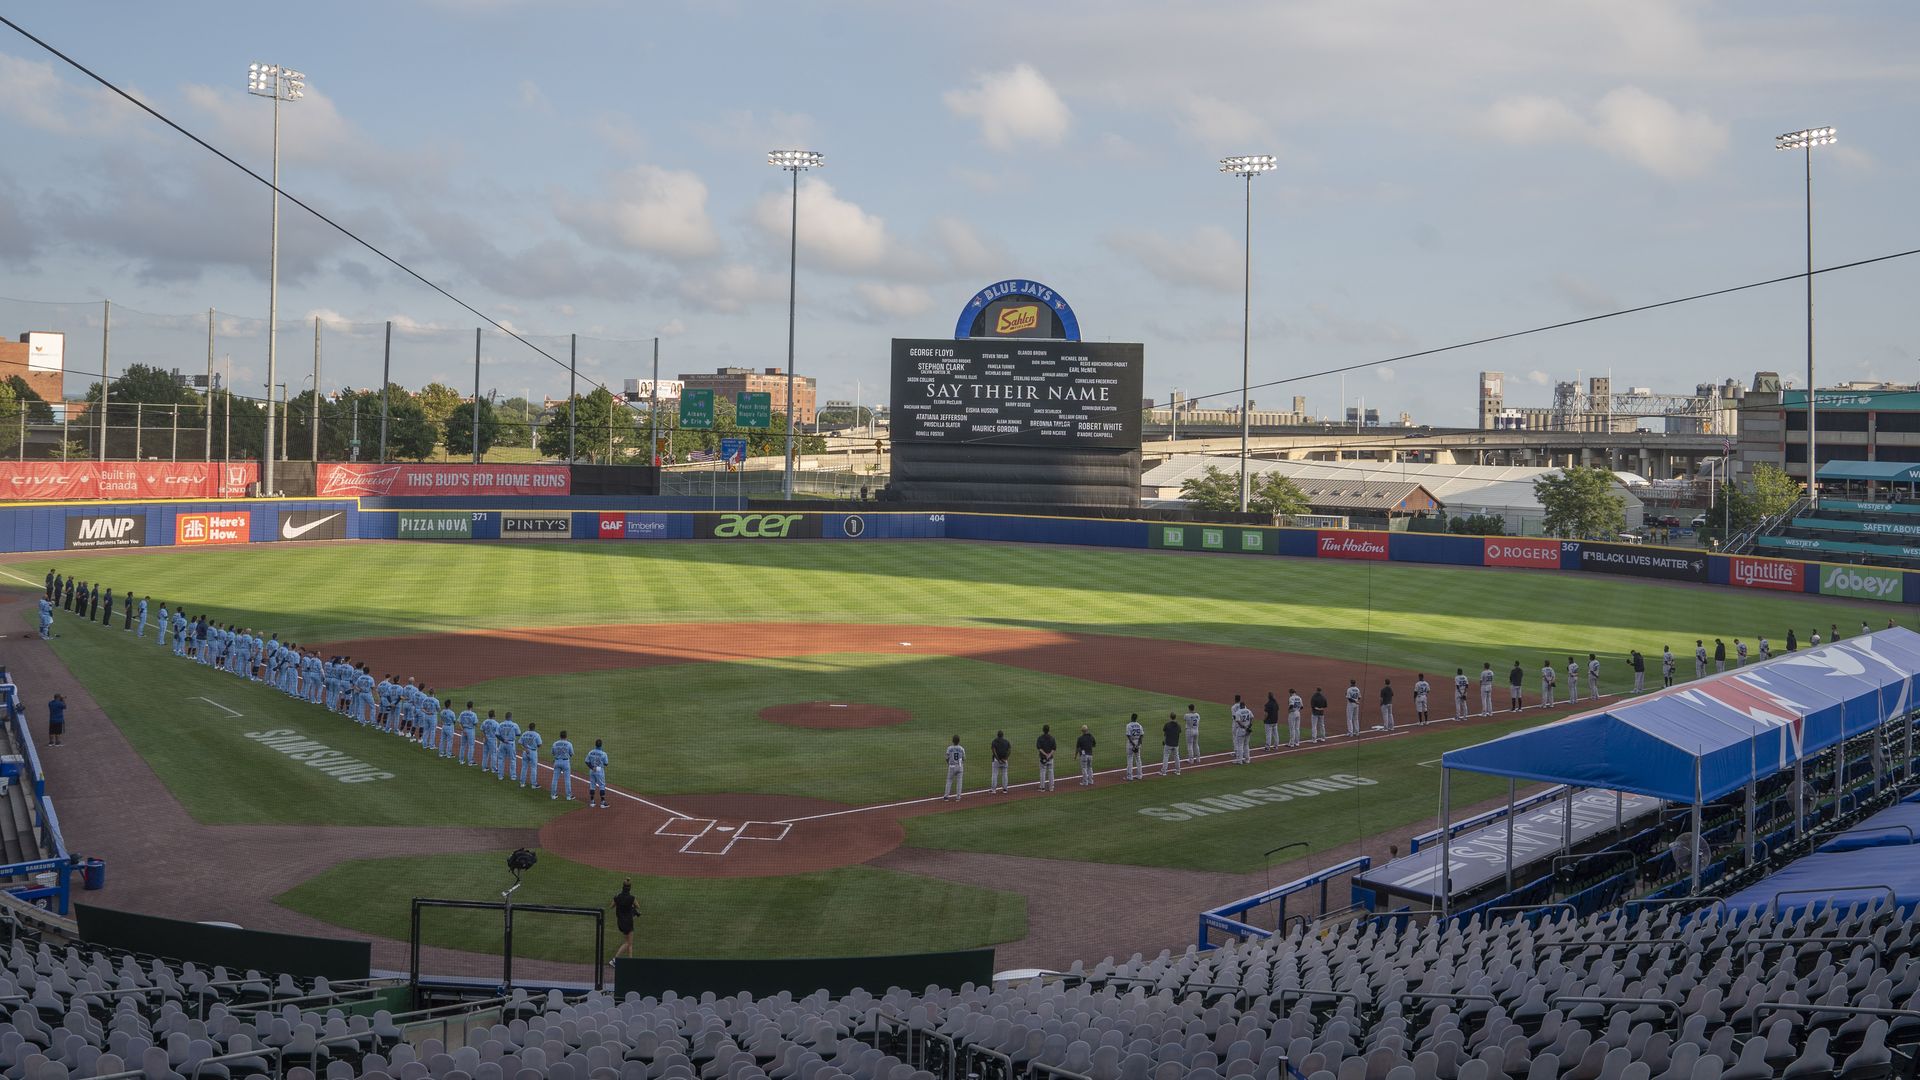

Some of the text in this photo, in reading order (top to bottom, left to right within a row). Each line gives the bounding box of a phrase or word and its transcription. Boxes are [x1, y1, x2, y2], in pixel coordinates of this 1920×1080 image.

[984, 282, 1053, 300] BLUE JAYS
[1001, 310, 1034, 330] Sahlen
[927, 384, 1109, 401] SAY THEIR NAME
[11, 476, 70, 485] CIVIC
[102, 470, 136, 480] Built in
[165, 476, 206, 484] CR-V
[330, 472, 393, 487] Budweiser
[408, 473, 566, 488] THIS BUD'S FOR HOME RUNS
[100, 481, 137, 490] Canada
[210, 516, 245, 527] Here's
[472, 512, 487, 521] 371
[930, 514, 945, 522] 404
[79, 518, 134, 539] MNP
[401, 518, 468, 532] PIZZA NOVA
[507, 520, 566, 530] PINTY'S
[601, 520, 623, 530] GAF
[628, 522, 664, 530] Timberline
[714, 514, 803, 538] acer
[1864, 524, 1920, 534] SAFETY ABOVE
[210, 529, 237, 539] How.
[1166, 530, 1182, 543] TD
[1205, 532, 1220, 544] TD
[1244, 534, 1260, 546] TD
[1321, 537, 1384, 553] Tim Hortons
[1562, 542, 1579, 552] 367
[1786, 540, 1813, 548] WESTJET
[1504, 546, 1558, 560] ROGERS
[1596, 552, 1688, 569] BLACK LIVES MATTER
[1736, 560, 1793, 584] Lightlife
[1824, 568, 1898, 596] Sobeys
[244, 728, 395, 783] SAMSUNG
[1138, 774, 1378, 821] SAMSUNG
